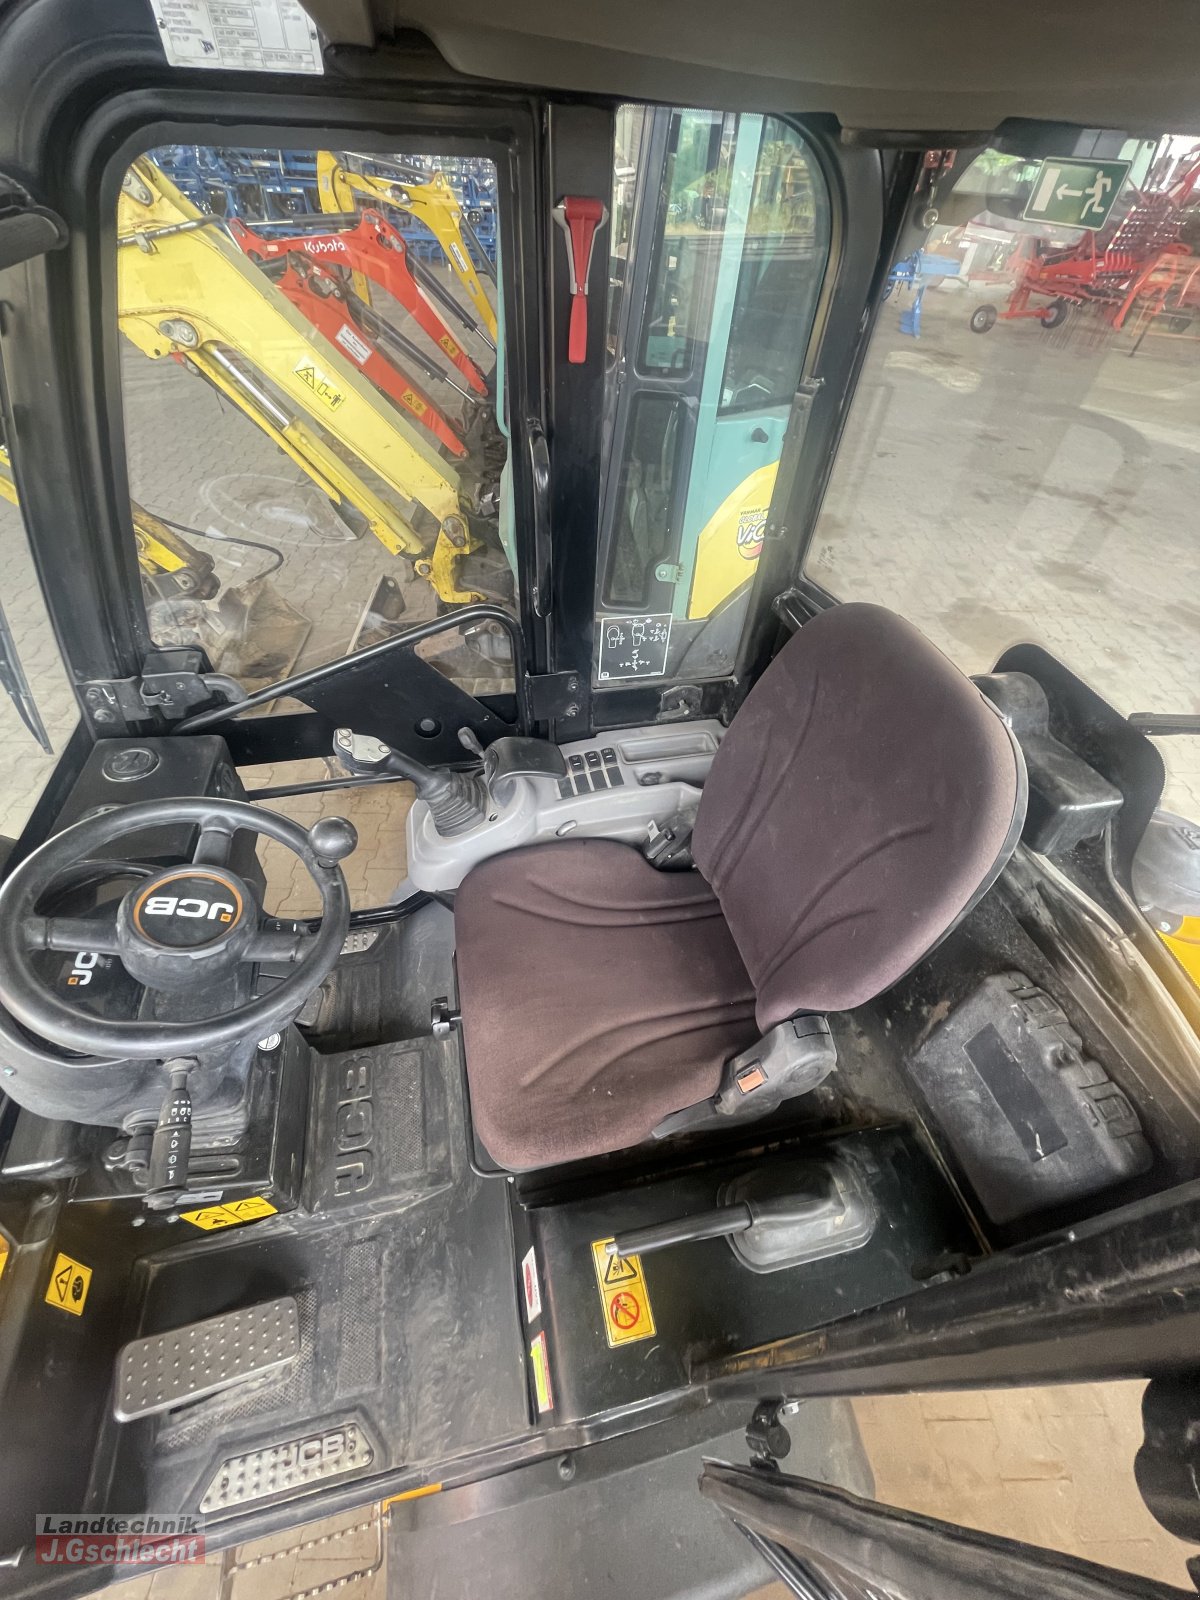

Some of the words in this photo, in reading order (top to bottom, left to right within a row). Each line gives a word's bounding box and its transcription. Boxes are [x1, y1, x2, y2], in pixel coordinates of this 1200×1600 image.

[304, 239, 346, 253] Kubota
[145, 896, 234, 922] JCB
[68, 952, 98, 985] JC
[335, 1056, 375, 1197] JCB
[275, 1433, 345, 1471] JCB
